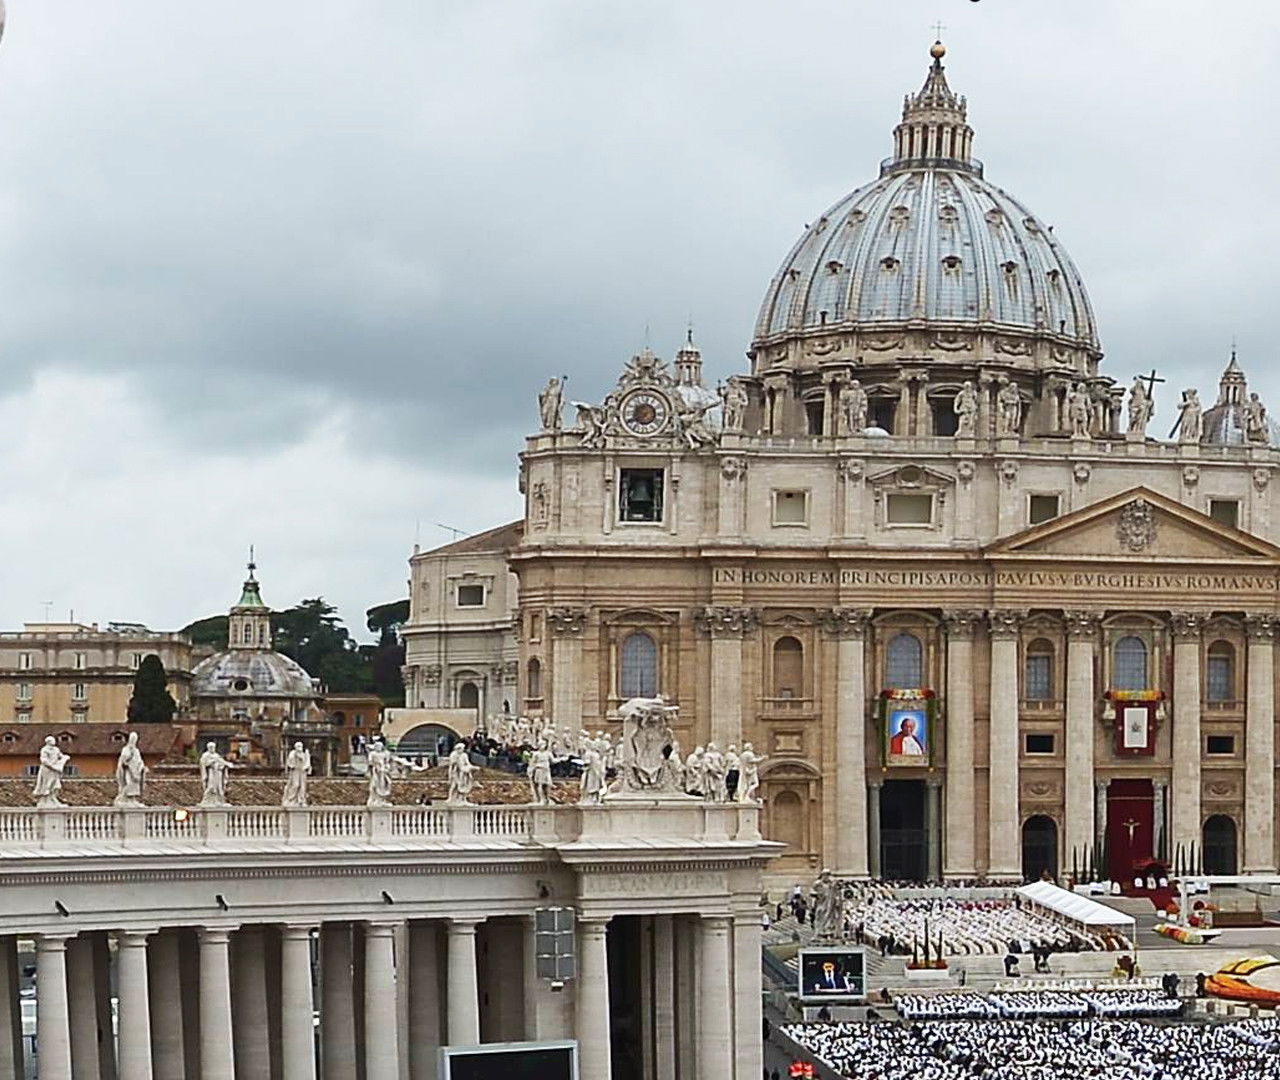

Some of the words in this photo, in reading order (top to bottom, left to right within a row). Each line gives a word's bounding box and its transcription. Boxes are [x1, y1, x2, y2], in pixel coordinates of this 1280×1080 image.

[715, 569, 735, 583] IN
[742, 570, 834, 584] HONOREM
[841, 571, 932, 585] PRINCIPIS
[997, 572, 1055, 586] PAVLVS
[1074, 573, 1182, 588] BVRGHESIVS
[1187, 576, 1274, 590] ROMANVS
